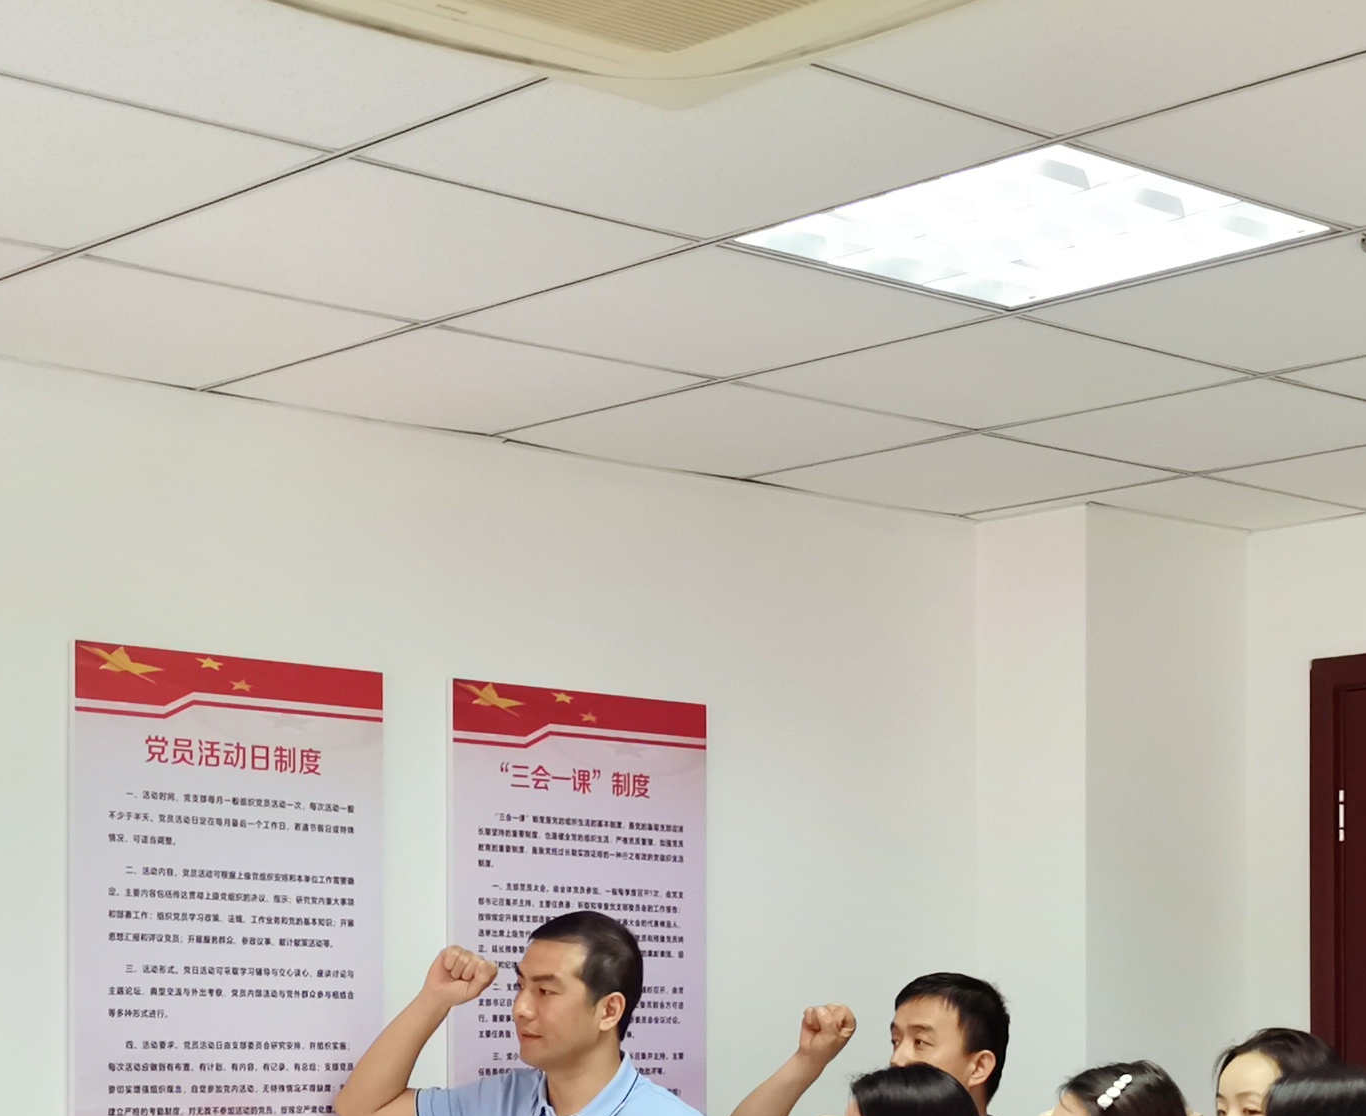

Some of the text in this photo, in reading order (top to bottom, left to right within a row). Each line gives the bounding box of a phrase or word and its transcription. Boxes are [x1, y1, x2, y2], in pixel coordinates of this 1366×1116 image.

[145, 735, 322, 776] 党员活动日制度
[500, 762, 650, 799] “三会一课”制度
